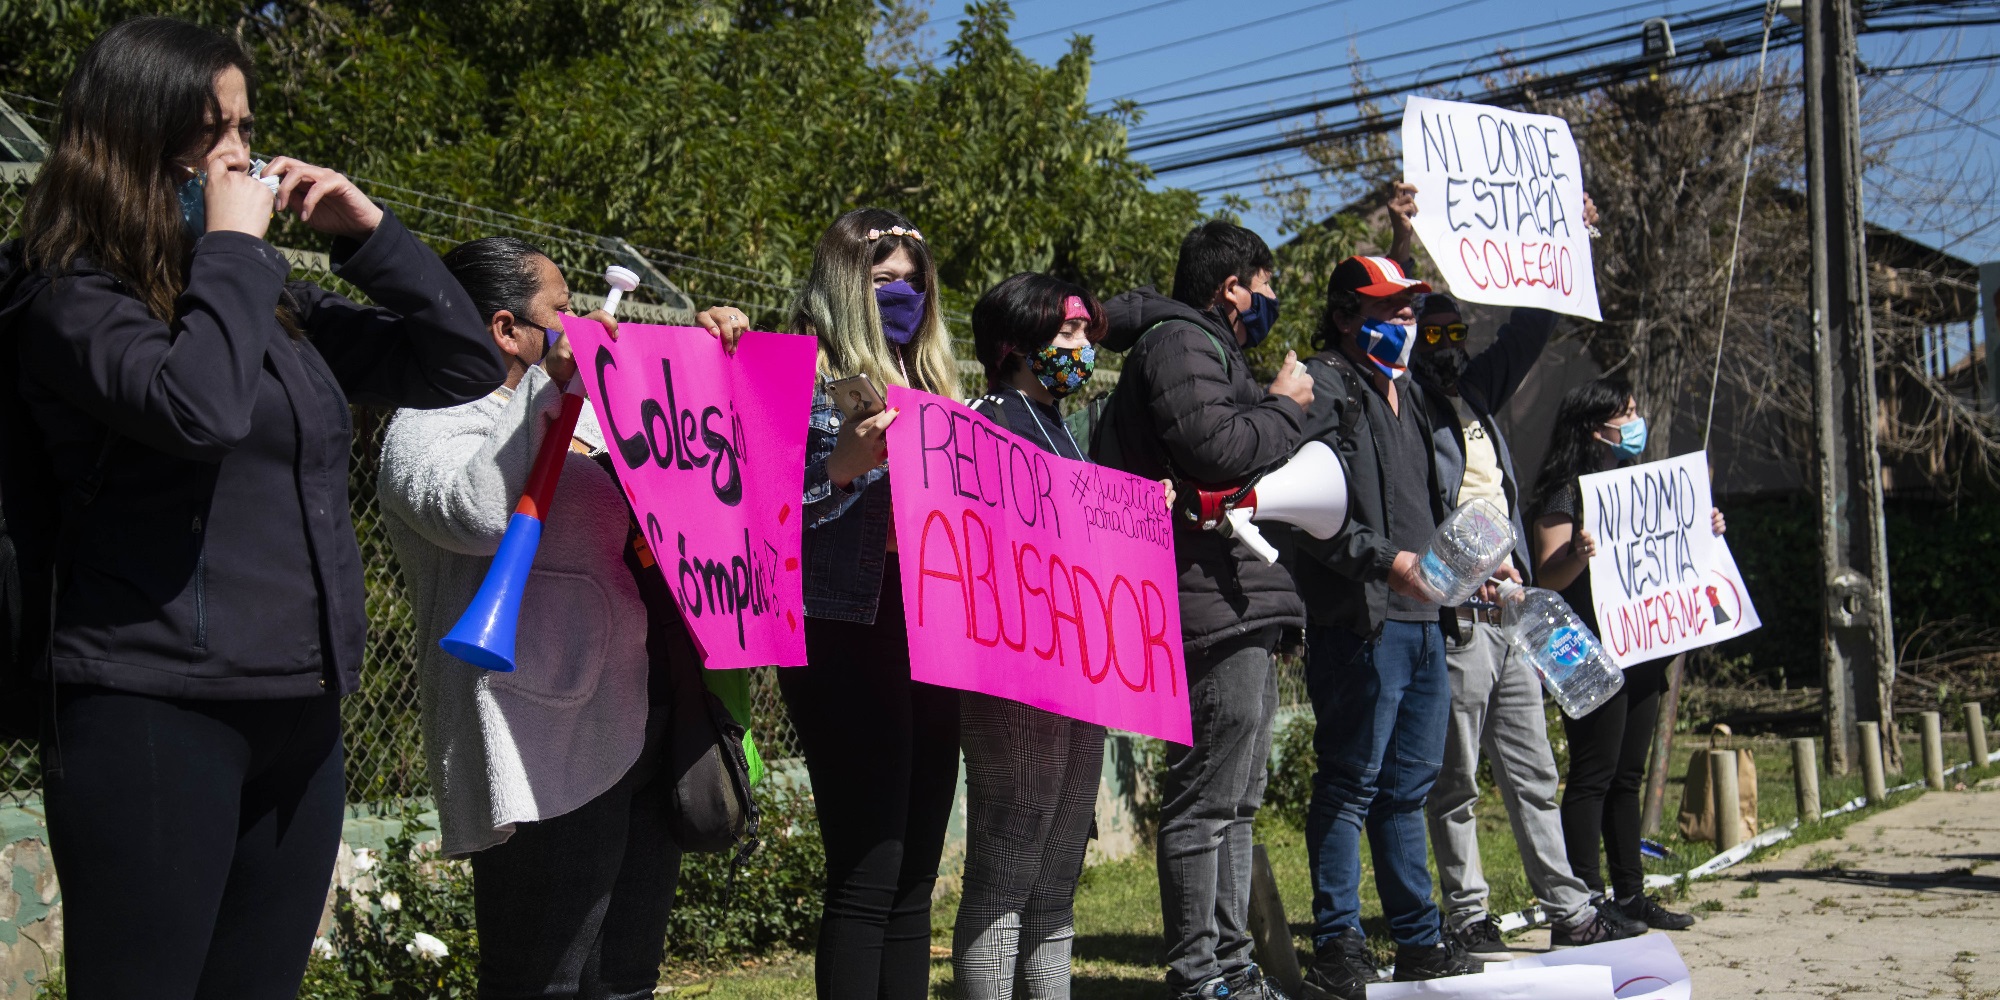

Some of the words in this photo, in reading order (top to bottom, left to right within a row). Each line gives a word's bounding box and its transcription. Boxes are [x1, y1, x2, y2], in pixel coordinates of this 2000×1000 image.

[1420, 110, 1463, 173] NI
[1477, 114, 1571, 183] DONDE
[1446, 176, 1571, 238] ESTABA
[594, 344, 748, 507] Colegio
[918, 402, 1062, 539] RECTOR
[1595, 482, 1621, 547] NI
[1630, 466, 1696, 538] COMO
[918, 508, 1177, 698] ABUSADOR
[1551, 643, 1572, 660] Pure
